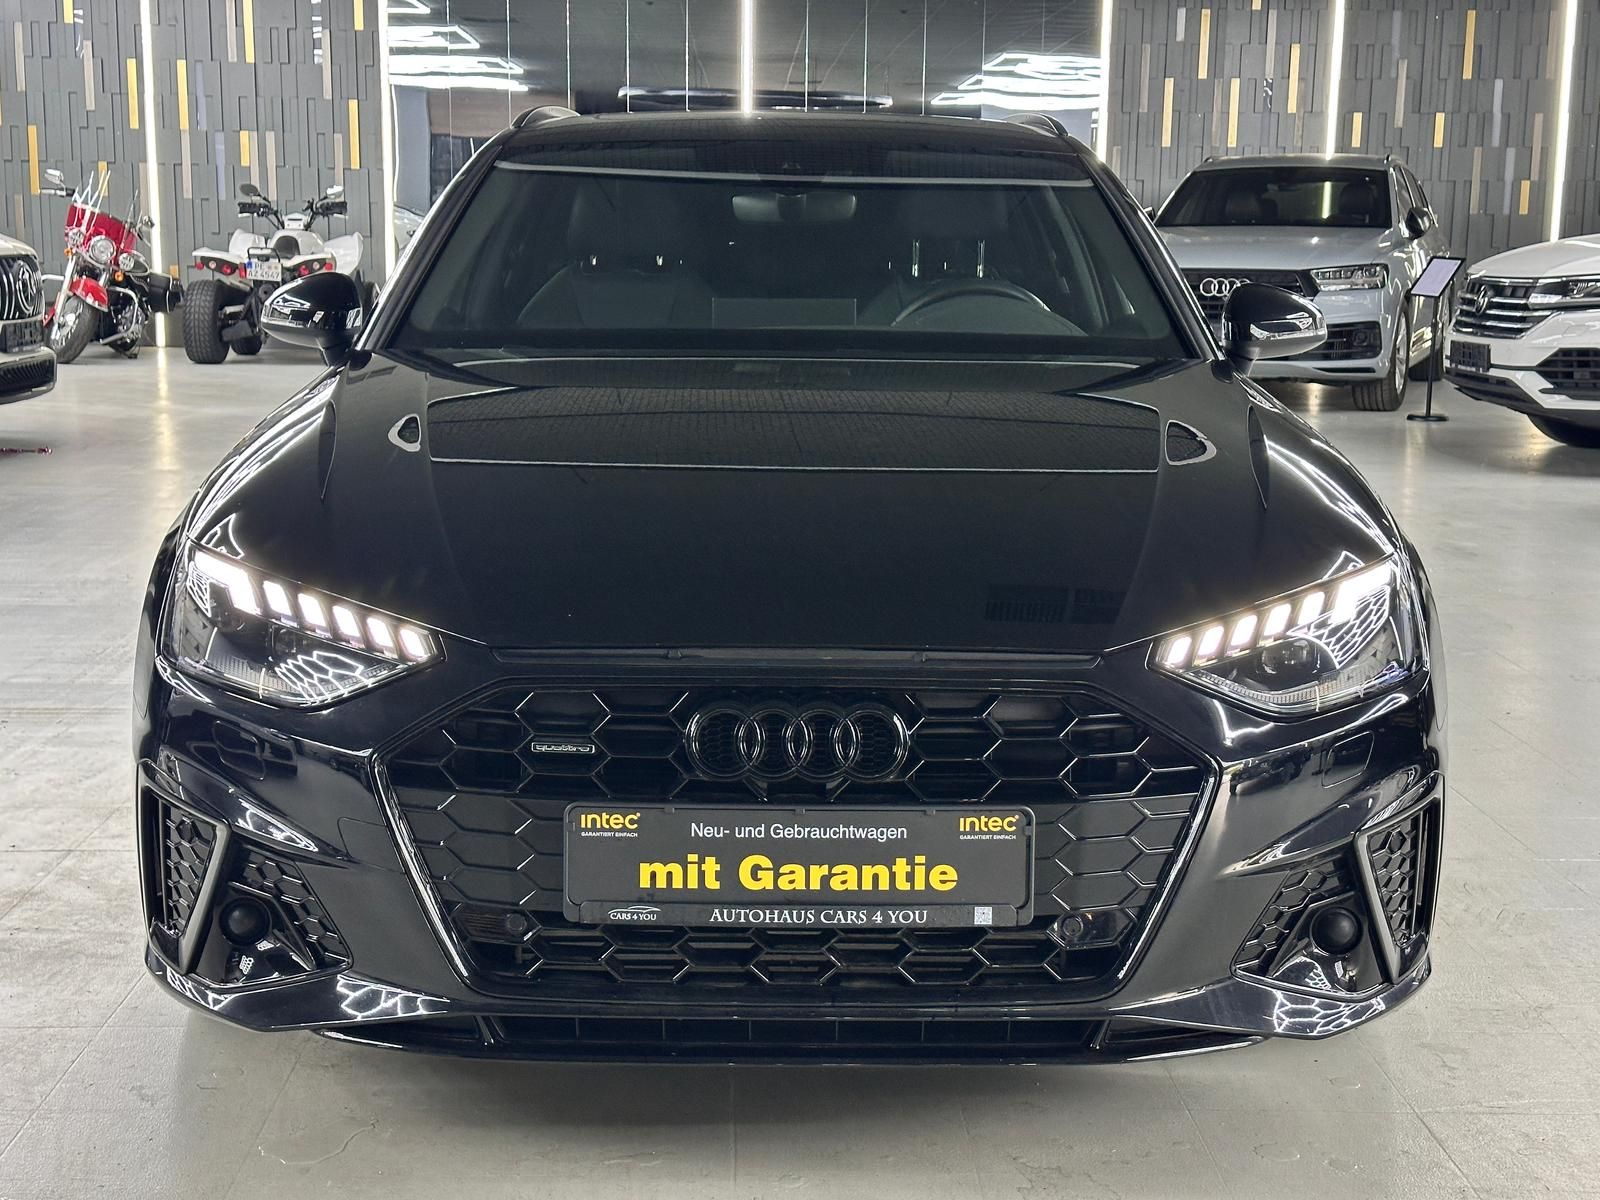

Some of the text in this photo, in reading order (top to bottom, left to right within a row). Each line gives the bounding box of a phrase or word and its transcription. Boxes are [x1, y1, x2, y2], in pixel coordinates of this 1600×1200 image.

[535, 744, 590, 752] quattro
[580, 812, 639, 830] intec
[959, 815, 1018, 832] intec
[691, 822, 907, 842] Neu- und Gebrauchtwagen
[639, 853, 959, 891] mit Garantie
[609, 912, 632, 921] CARS
[638, 913, 657, 921] YOU
[709, 908, 928, 925] AUTOHAUS CARS 4 YOU
